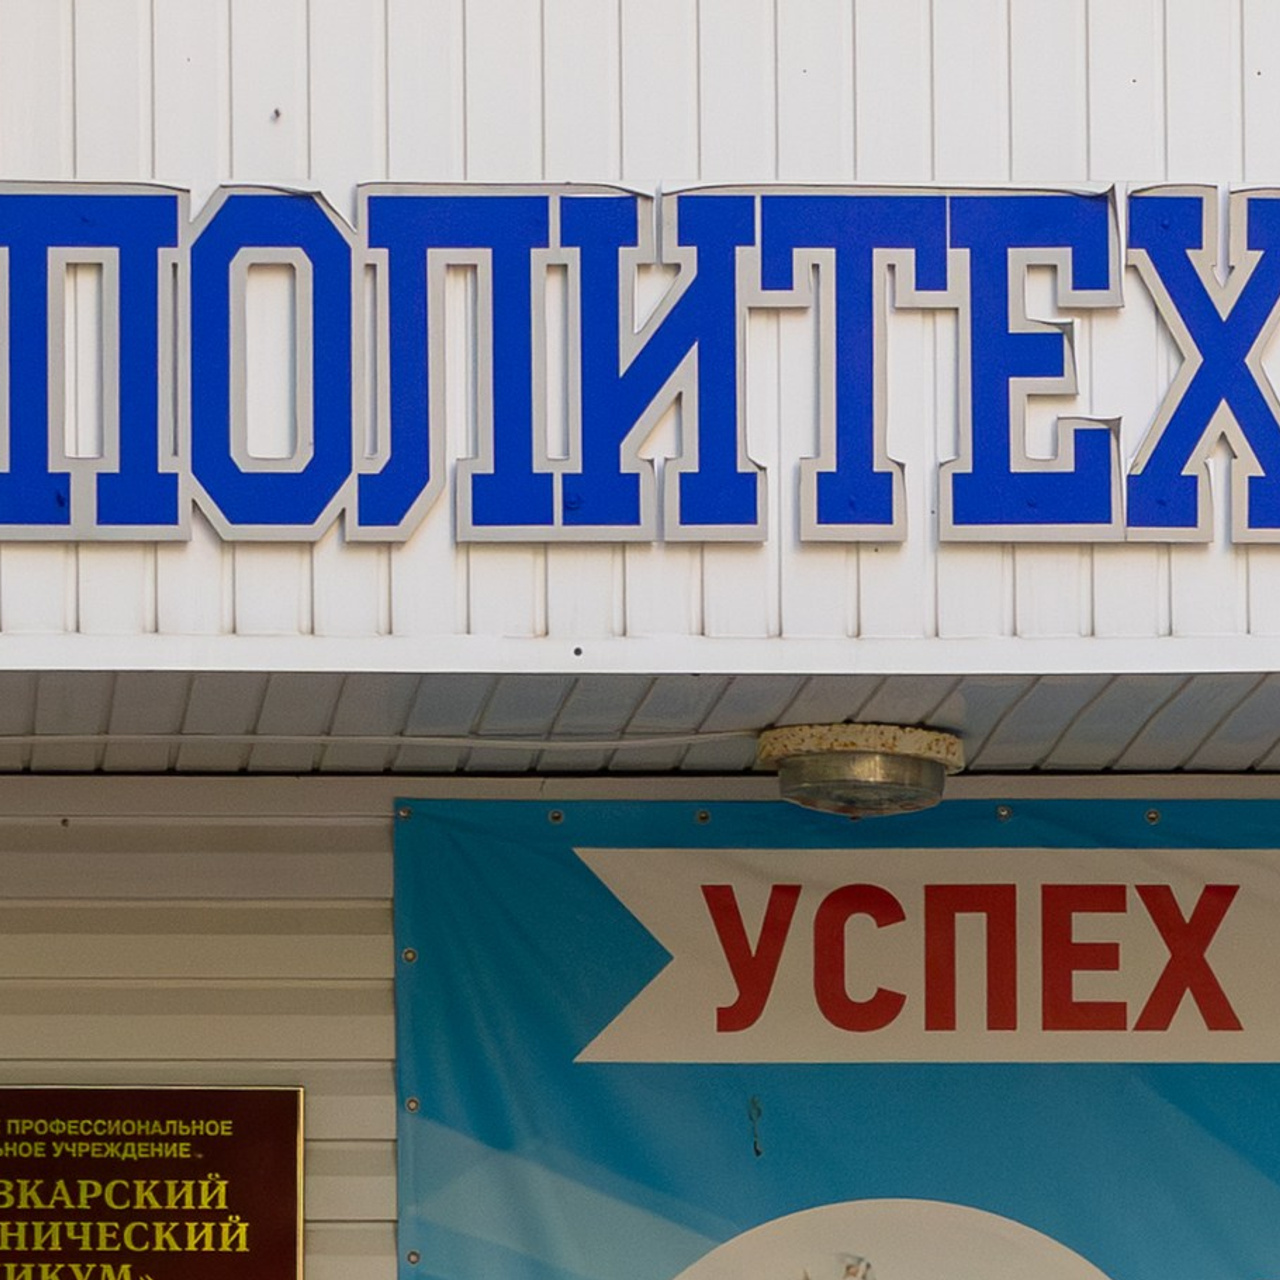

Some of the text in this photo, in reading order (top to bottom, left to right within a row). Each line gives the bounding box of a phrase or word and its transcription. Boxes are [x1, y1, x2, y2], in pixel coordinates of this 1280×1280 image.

[700, 883, 1245, 1033] УСПЕХ
[6, 1119, 233, 1136] ПРОФЕССИОНАЛЬНОЕ
[52, 1141, 192, 1161] УЧРЕЖДЕНИЕ
